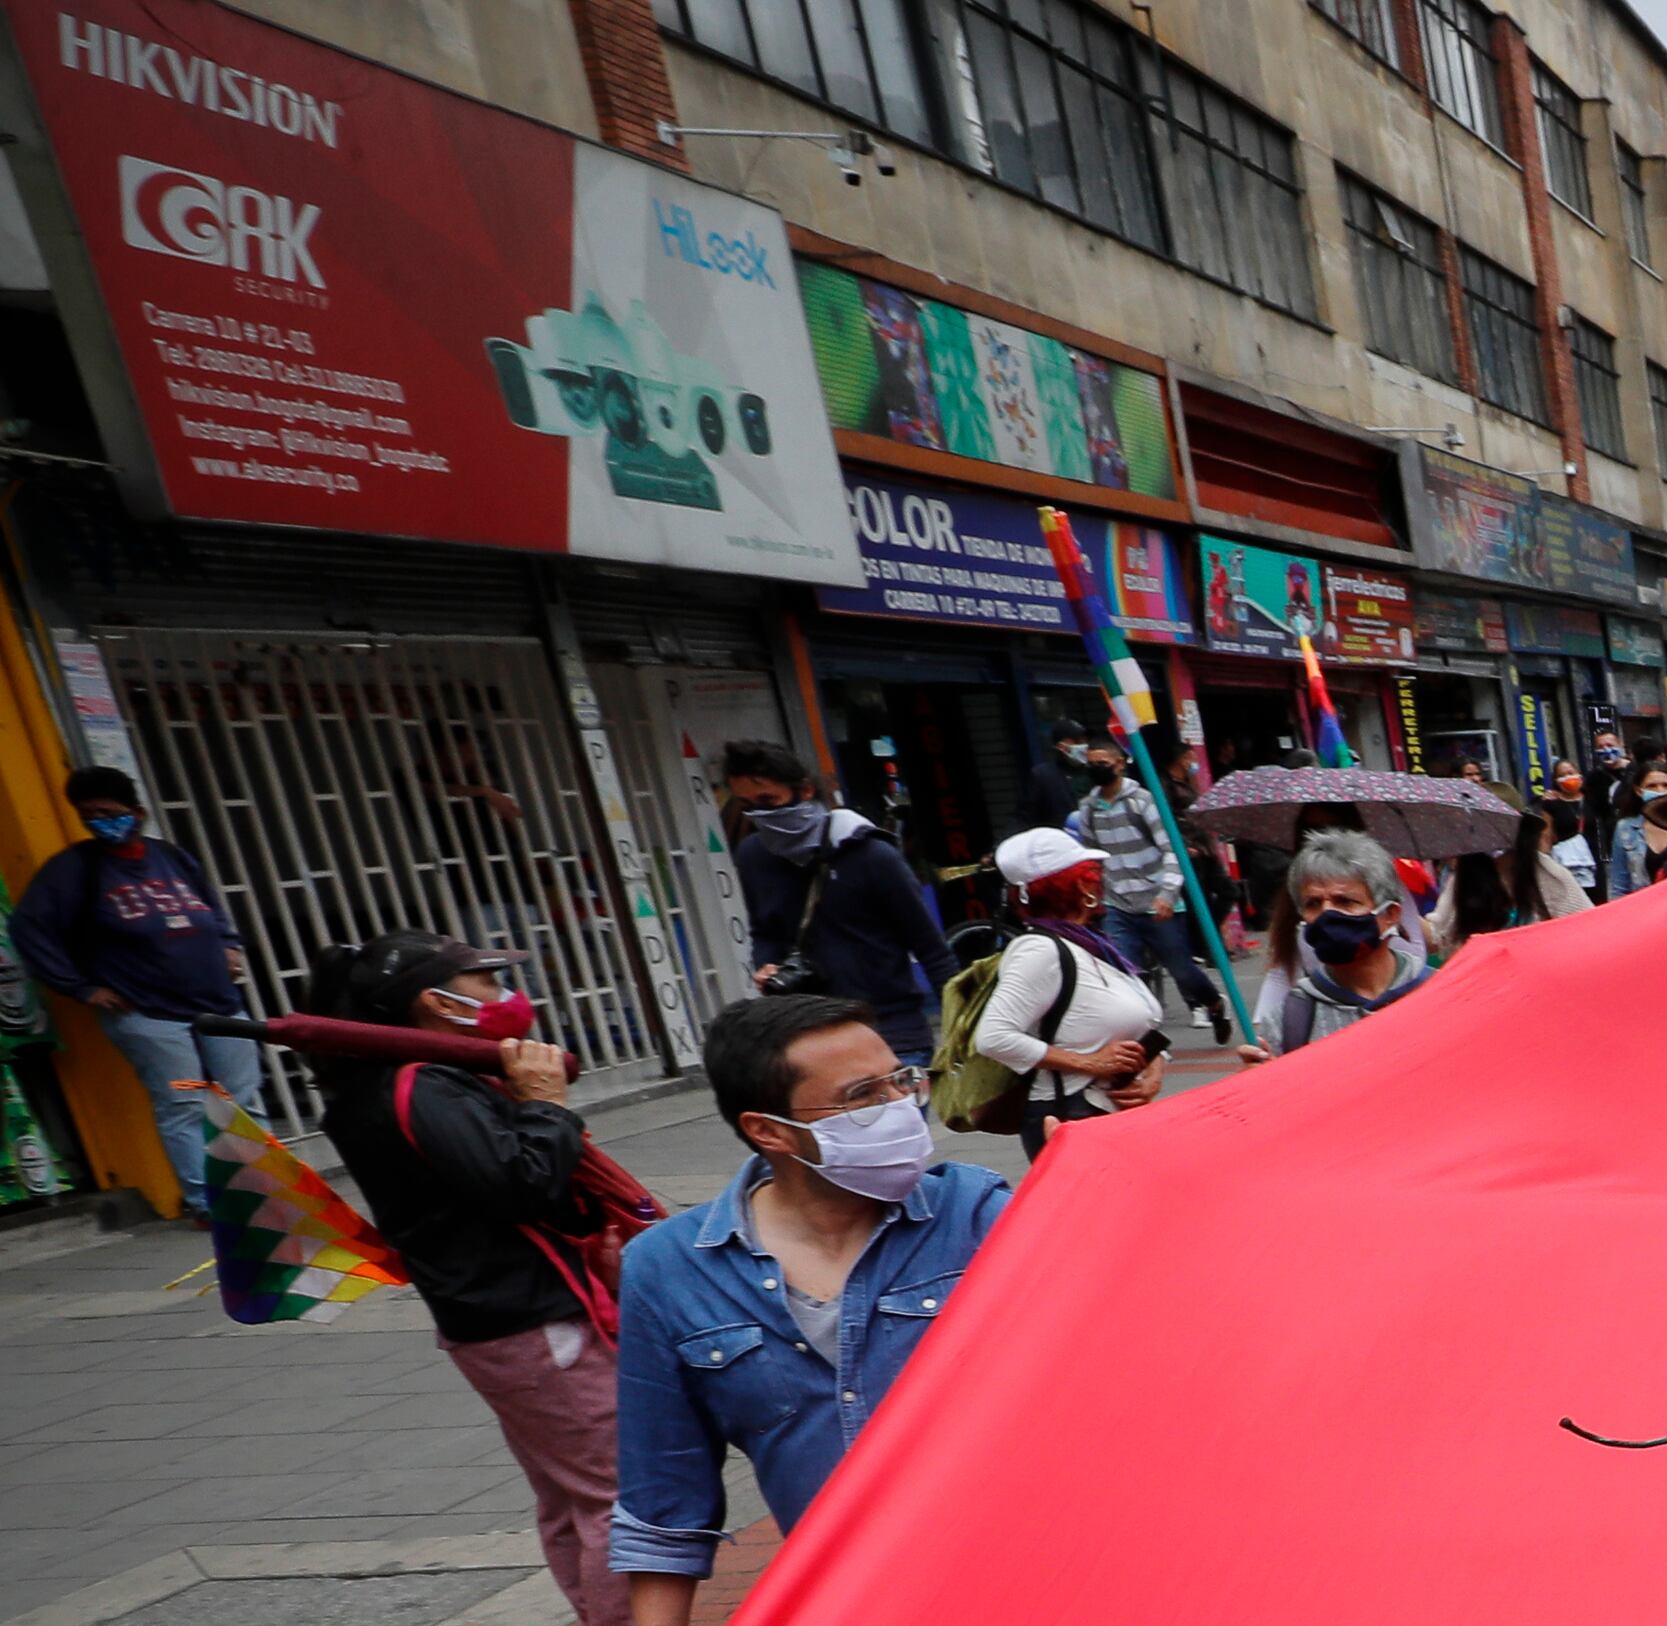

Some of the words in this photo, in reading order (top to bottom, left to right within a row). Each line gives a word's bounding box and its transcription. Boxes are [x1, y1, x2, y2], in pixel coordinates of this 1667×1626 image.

[58, 13, 338, 148] HIKVISION
[234, 276, 329, 310] SECURITY
[143, 301, 217, 336] Carrera
[848, 484, 962, 554] OLOR
[106, 877, 212, 920] USA
